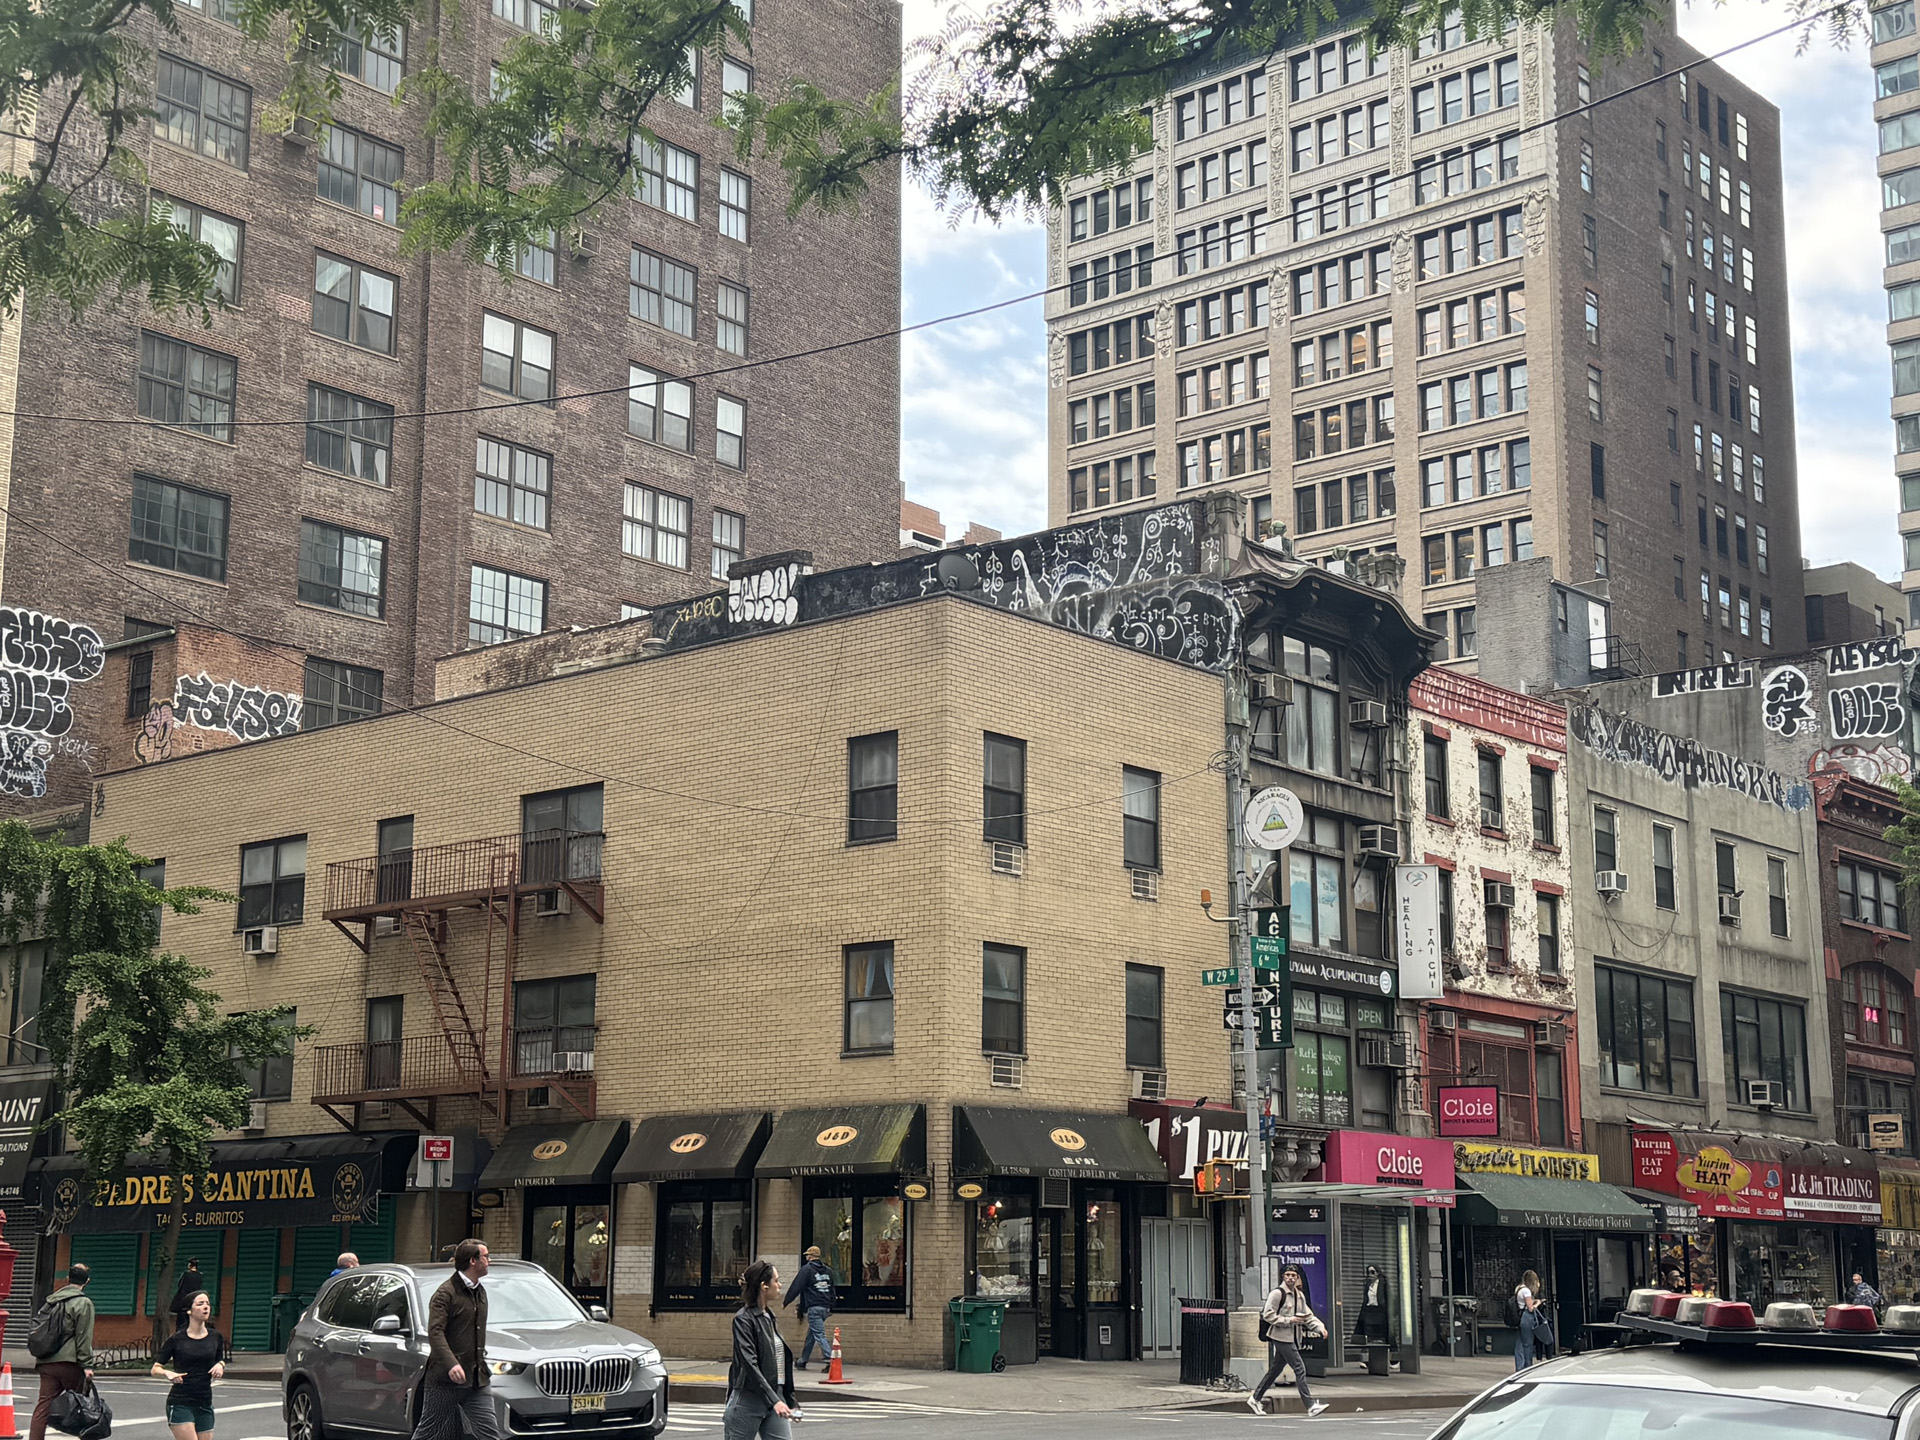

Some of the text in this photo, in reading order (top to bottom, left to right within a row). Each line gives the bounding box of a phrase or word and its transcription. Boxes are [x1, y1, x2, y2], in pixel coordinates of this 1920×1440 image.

[1402, 897, 1413, 956] HEALING
[1427, 929, 1436, 988] TAI CHI
[1206, 971, 1213, 983] W
[1216, 970, 1227, 982] 29
[1320, 964, 1379, 986] ACUPUNCTURE
[1357, 1008, 1382, 1024] OPEN
[1444, 1098, 1494, 1116] Cloie
[1634, 1138, 1672, 1150] Yurim
[1377, 1147, 1424, 1175] Cloie
[1521, 1153, 1591, 1179] FLORISTS
[1641, 1157, 1663, 1167] HAT
[1699, 1156, 1730, 1171] Yurim
[650, 1170, 697, 1181] EXPORTER
[790, 1165, 854, 1177] WHOLESALER
[1079, 1168, 1106, 1179] JEWELRY
[1642, 1167, 1663, 1176] CAP
[1695, 1170, 1731, 1187] HAT
[202, 1167, 316, 1202] CANTINA
[514, 1176, 557, 1187] IMPORTER
[1790, 1173, 1796, 1194] J
[1798, 1173, 1807, 1196] &
[1809, 1174, 1823, 1196] Jin
[1824, 1176, 1873, 1199] TRADING
[195, 1210, 244, 1226] BURRITOS
[1525, 1212, 1541, 1225] New
[1544, 1213, 1571, 1228] York's
[1573, 1214, 1604, 1230] Leading
[1606, 1215, 1632, 1229] Florist
[1284, 1244, 1302, 1254] next
[1304, 1242, 1321, 1254] hire
[1287, 1255, 1315, 1265] human
